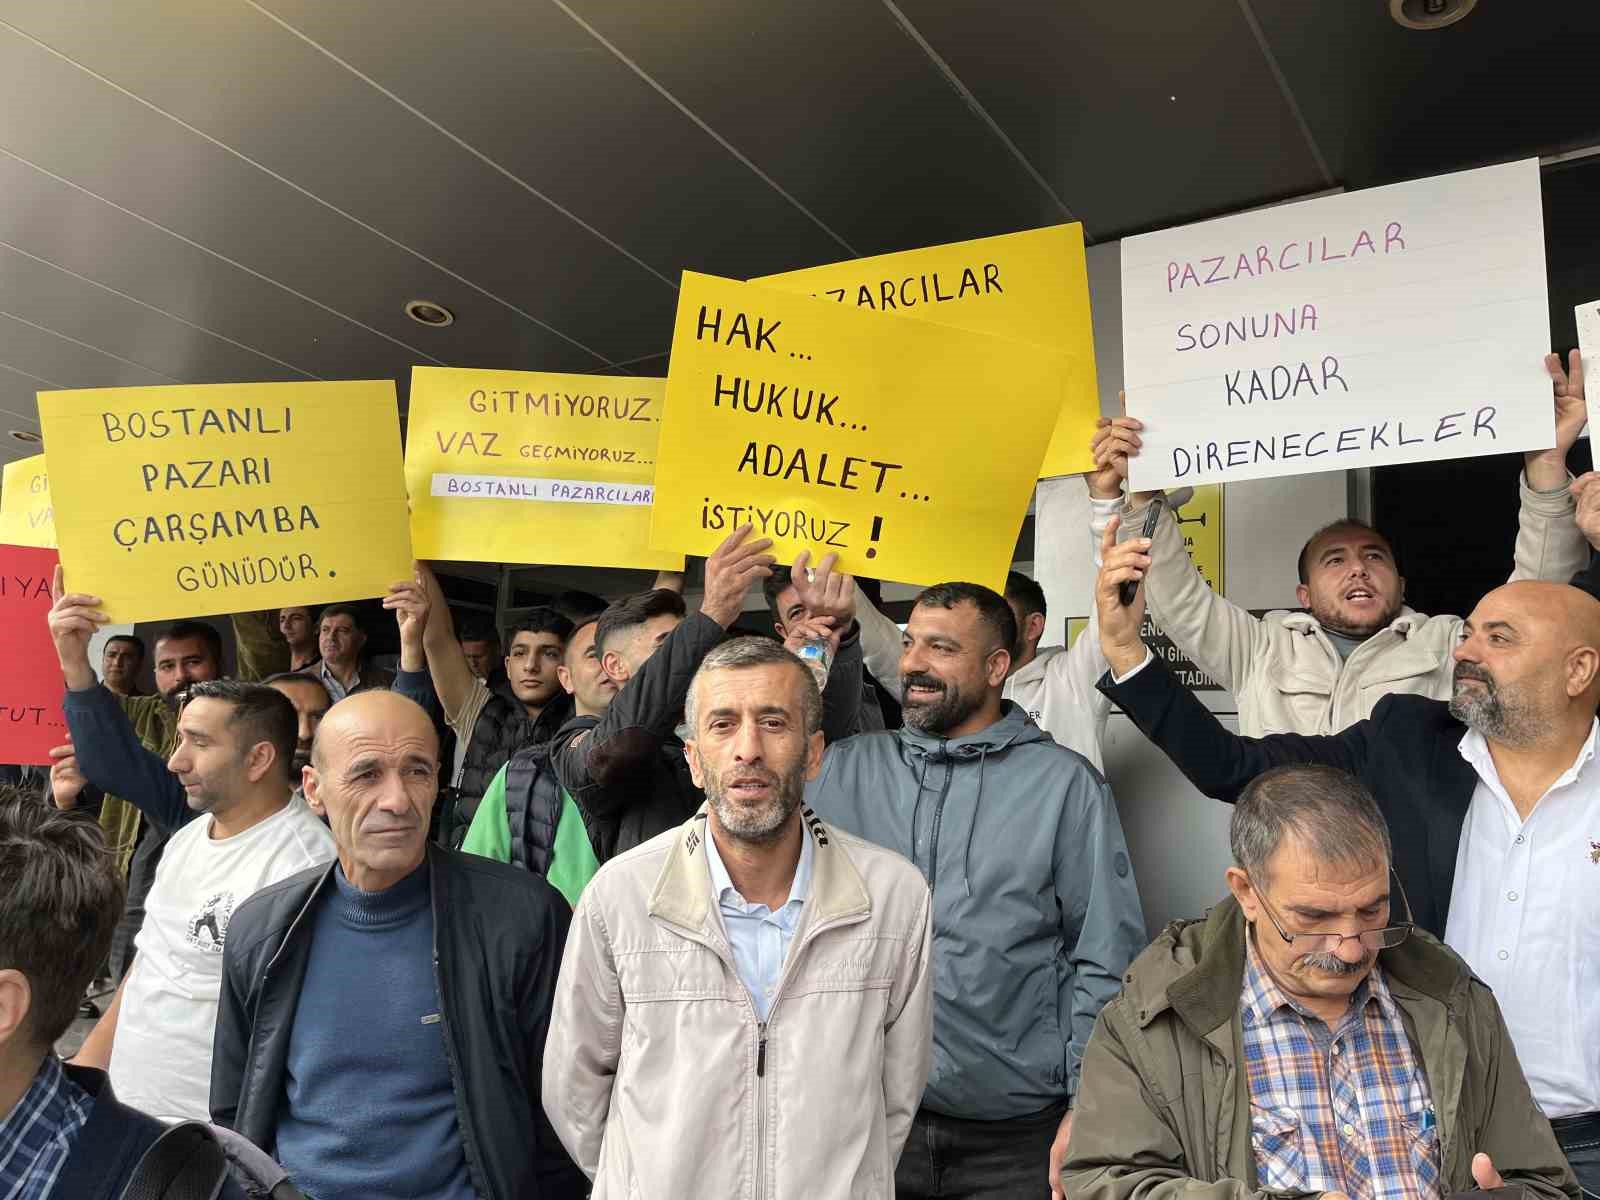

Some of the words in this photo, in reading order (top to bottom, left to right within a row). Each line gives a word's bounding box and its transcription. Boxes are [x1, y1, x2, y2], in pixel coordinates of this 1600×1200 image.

[1168, 221, 1405, 293] PAZARCILAR
[811, 263, 1003, 311] ARCILAR
[696, 304, 812, 361] HAK...
[1176, 303, 1319, 352] SONUNA
[714, 373, 868, 431] HUKUK...
[1225, 355, 1349, 406] KADAR
[102, 406, 292, 443] BOSTANLI
[436, 431, 503, 457] VAZ
[1172, 405, 1497, 479] DİRENECEKLER
[142, 456, 272, 492] PAZARI
[447, 478, 537, 498] BOSTANLI
[551, 483, 655, 504] PAZARCILARI
[737, 441, 931, 502] ADALET...
[113, 504, 321, 552] ÇARŞAMBA
[176, 552, 337, 592] GÜNÜDÜR.
